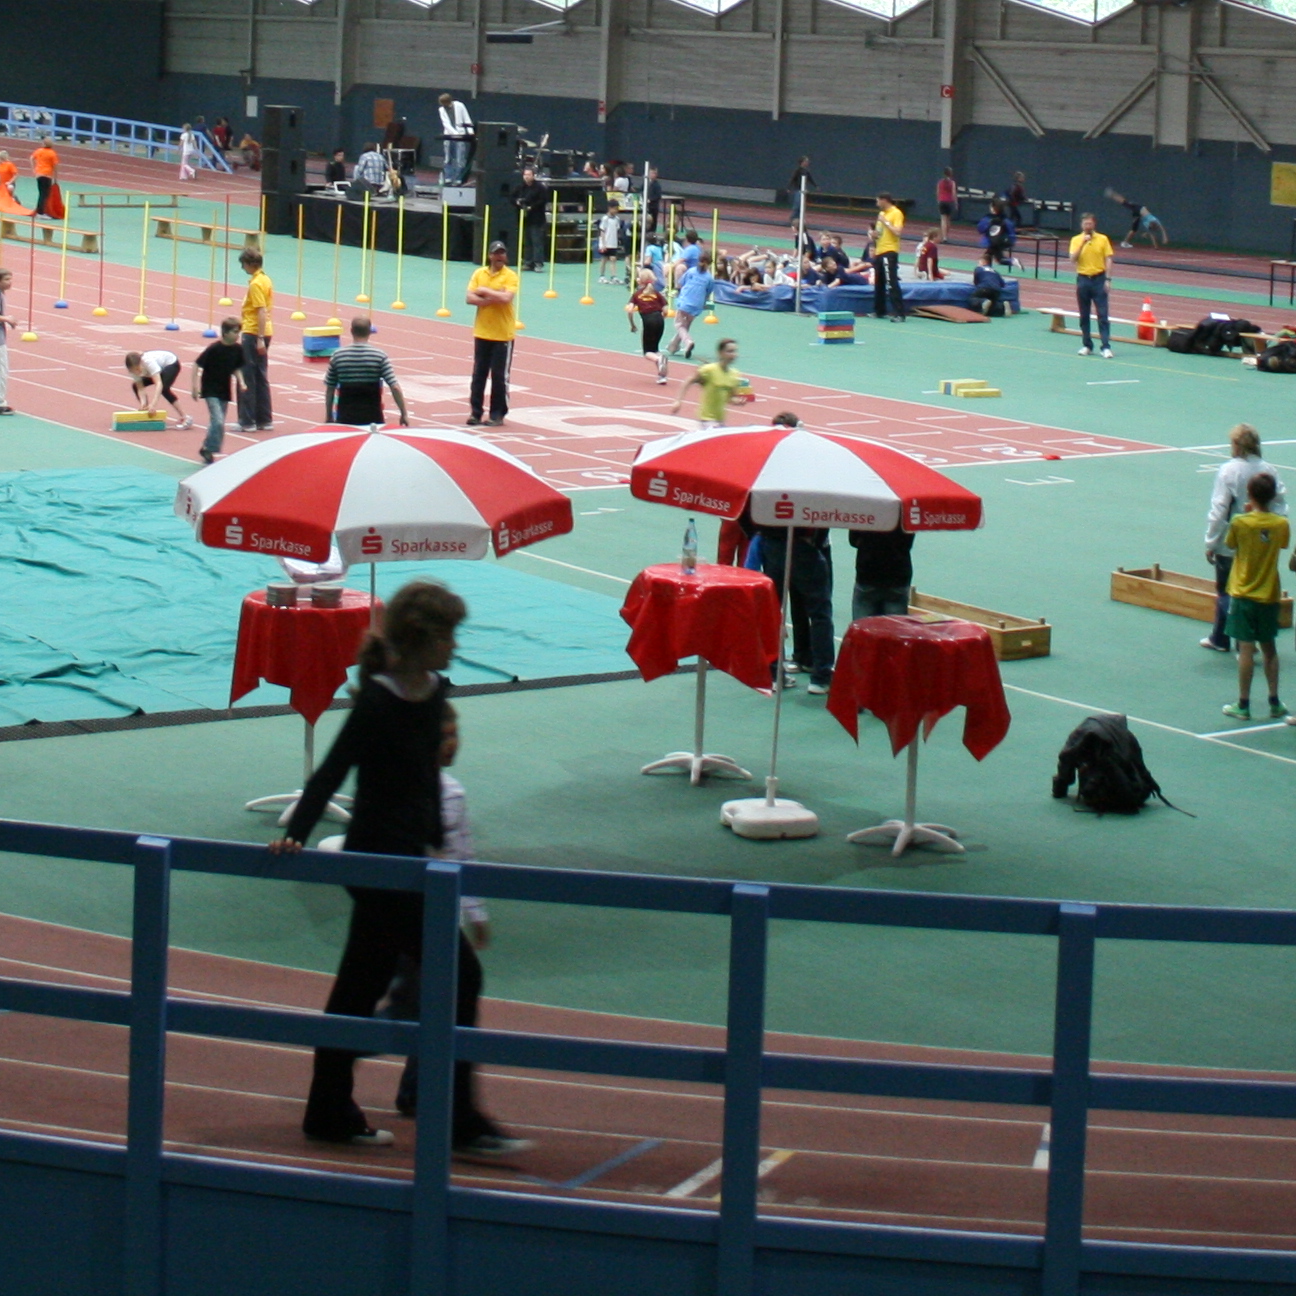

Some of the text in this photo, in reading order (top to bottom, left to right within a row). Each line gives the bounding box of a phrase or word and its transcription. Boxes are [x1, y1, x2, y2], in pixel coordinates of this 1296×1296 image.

[672, 487, 731, 513] Sparkasse
[801, 507, 876, 526] Sparkasse
[922, 511, 967, 525] Sparkasse
[511, 519, 554, 545] Sparkasse
[249, 533, 312, 557] Sparkasse
[390, 538, 468, 555] Sparkasse
